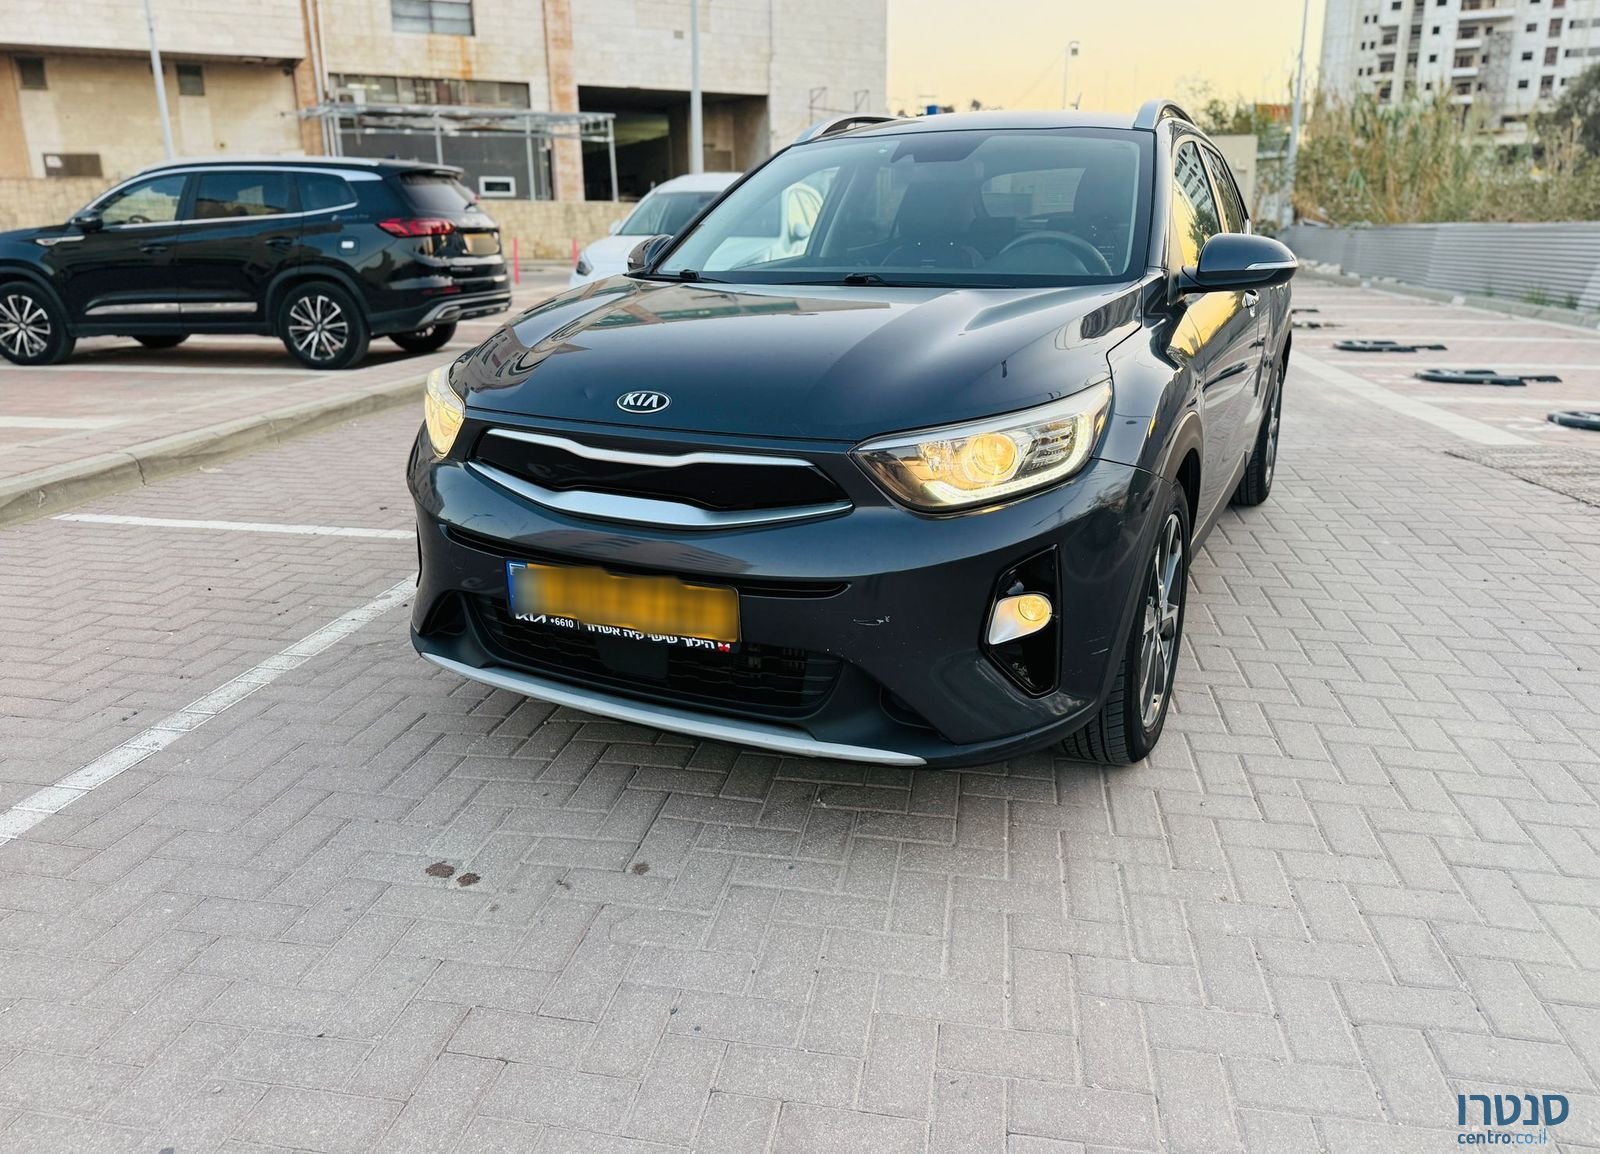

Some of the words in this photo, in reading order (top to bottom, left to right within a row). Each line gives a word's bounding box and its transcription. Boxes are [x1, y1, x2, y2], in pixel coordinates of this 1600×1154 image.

[622, 393, 659, 408] KIA
[622, 628, 645, 641] קיה
[647, 633, 678, 644] שישי
[681, 637, 716, 650] הילוך
